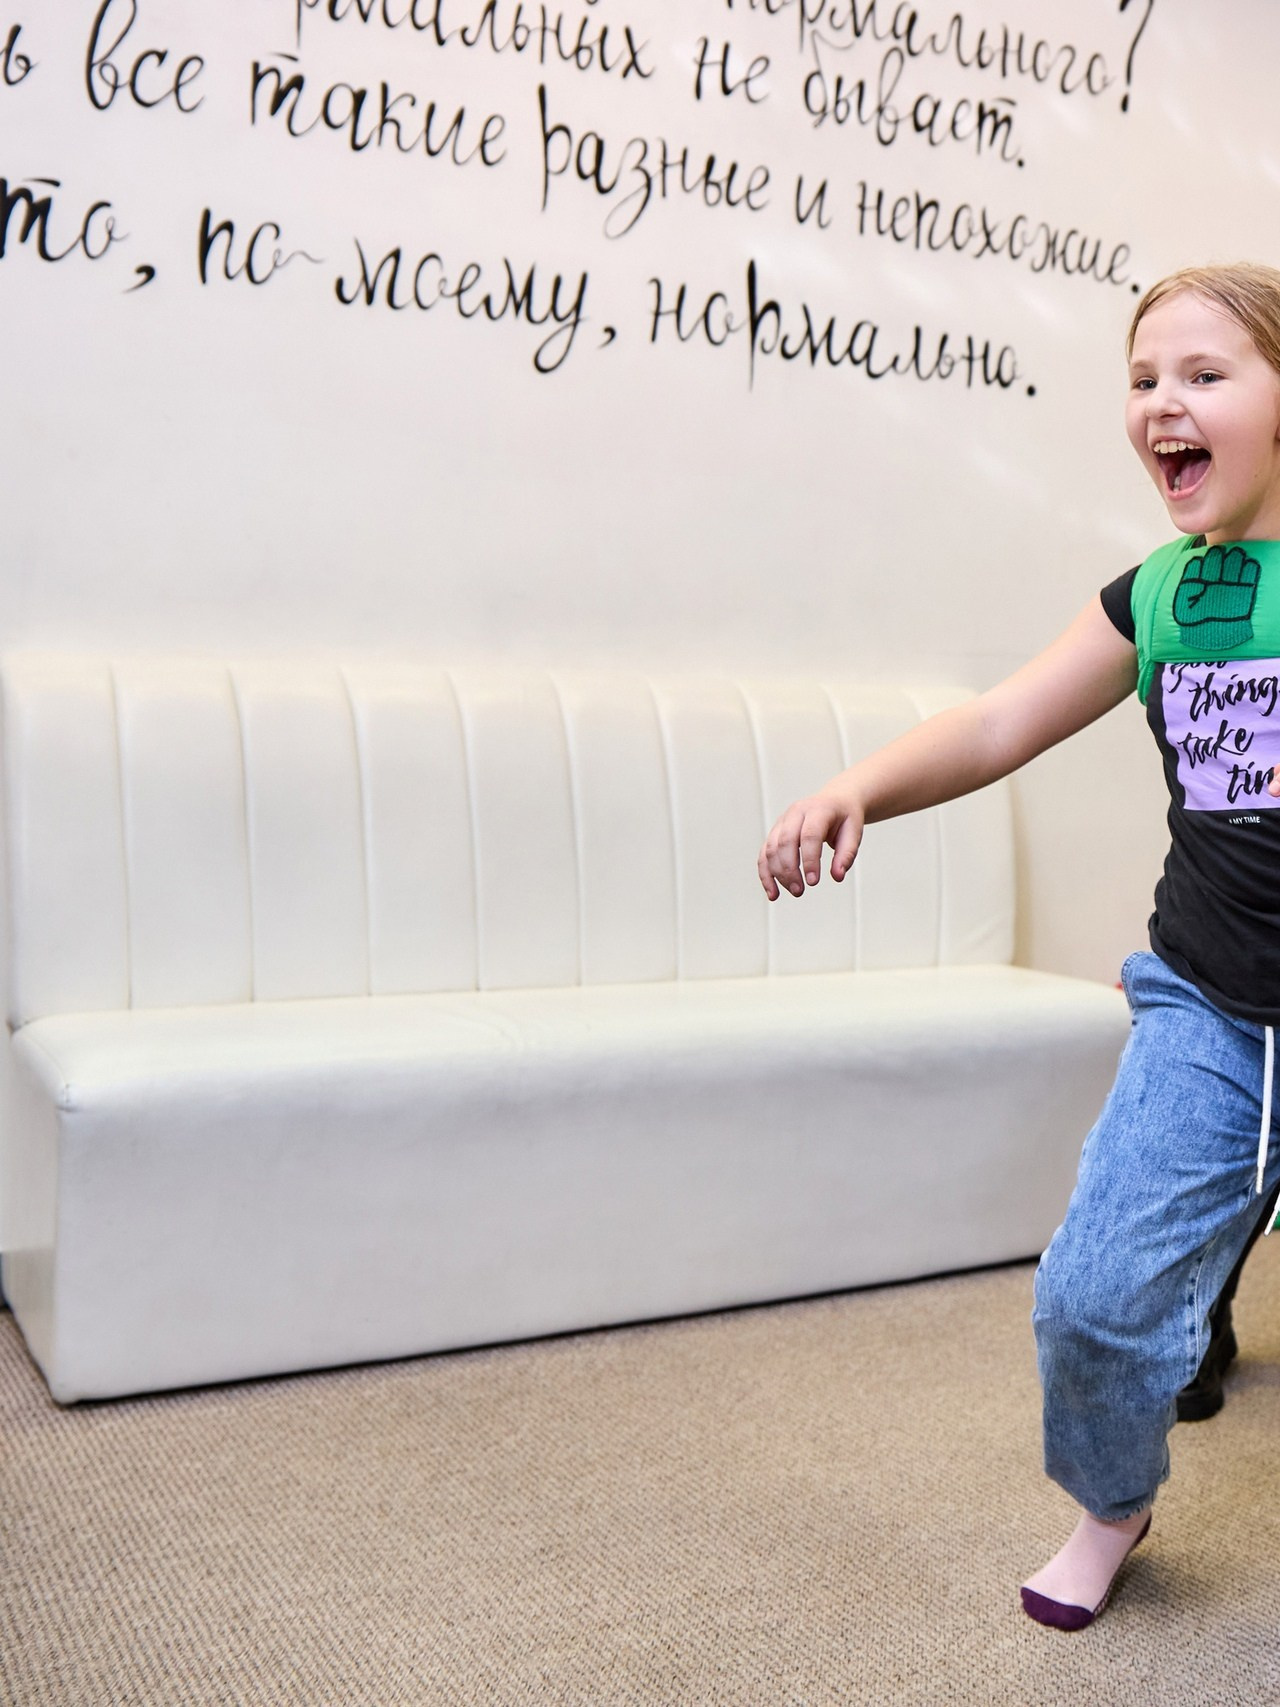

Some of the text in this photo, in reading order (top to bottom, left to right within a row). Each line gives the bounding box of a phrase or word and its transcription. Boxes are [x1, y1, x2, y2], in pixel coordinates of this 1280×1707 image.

[693, 35, 771, 105] не
[802, 30, 1026, 170] бывает.
[725, 0, 1153, 113] мального?
[84, 0, 206, 114] все
[250, 52, 507, 168] такие
[537, 83, 773, 240] разные
[794, 174, 832, 231] и
[856, 180, 1140, 294] непохожие.
[647, 258, 1038, 399] нормально.
[1177, 719, 1255, 769] take
[1243, 815, 1261, 823] TIME
